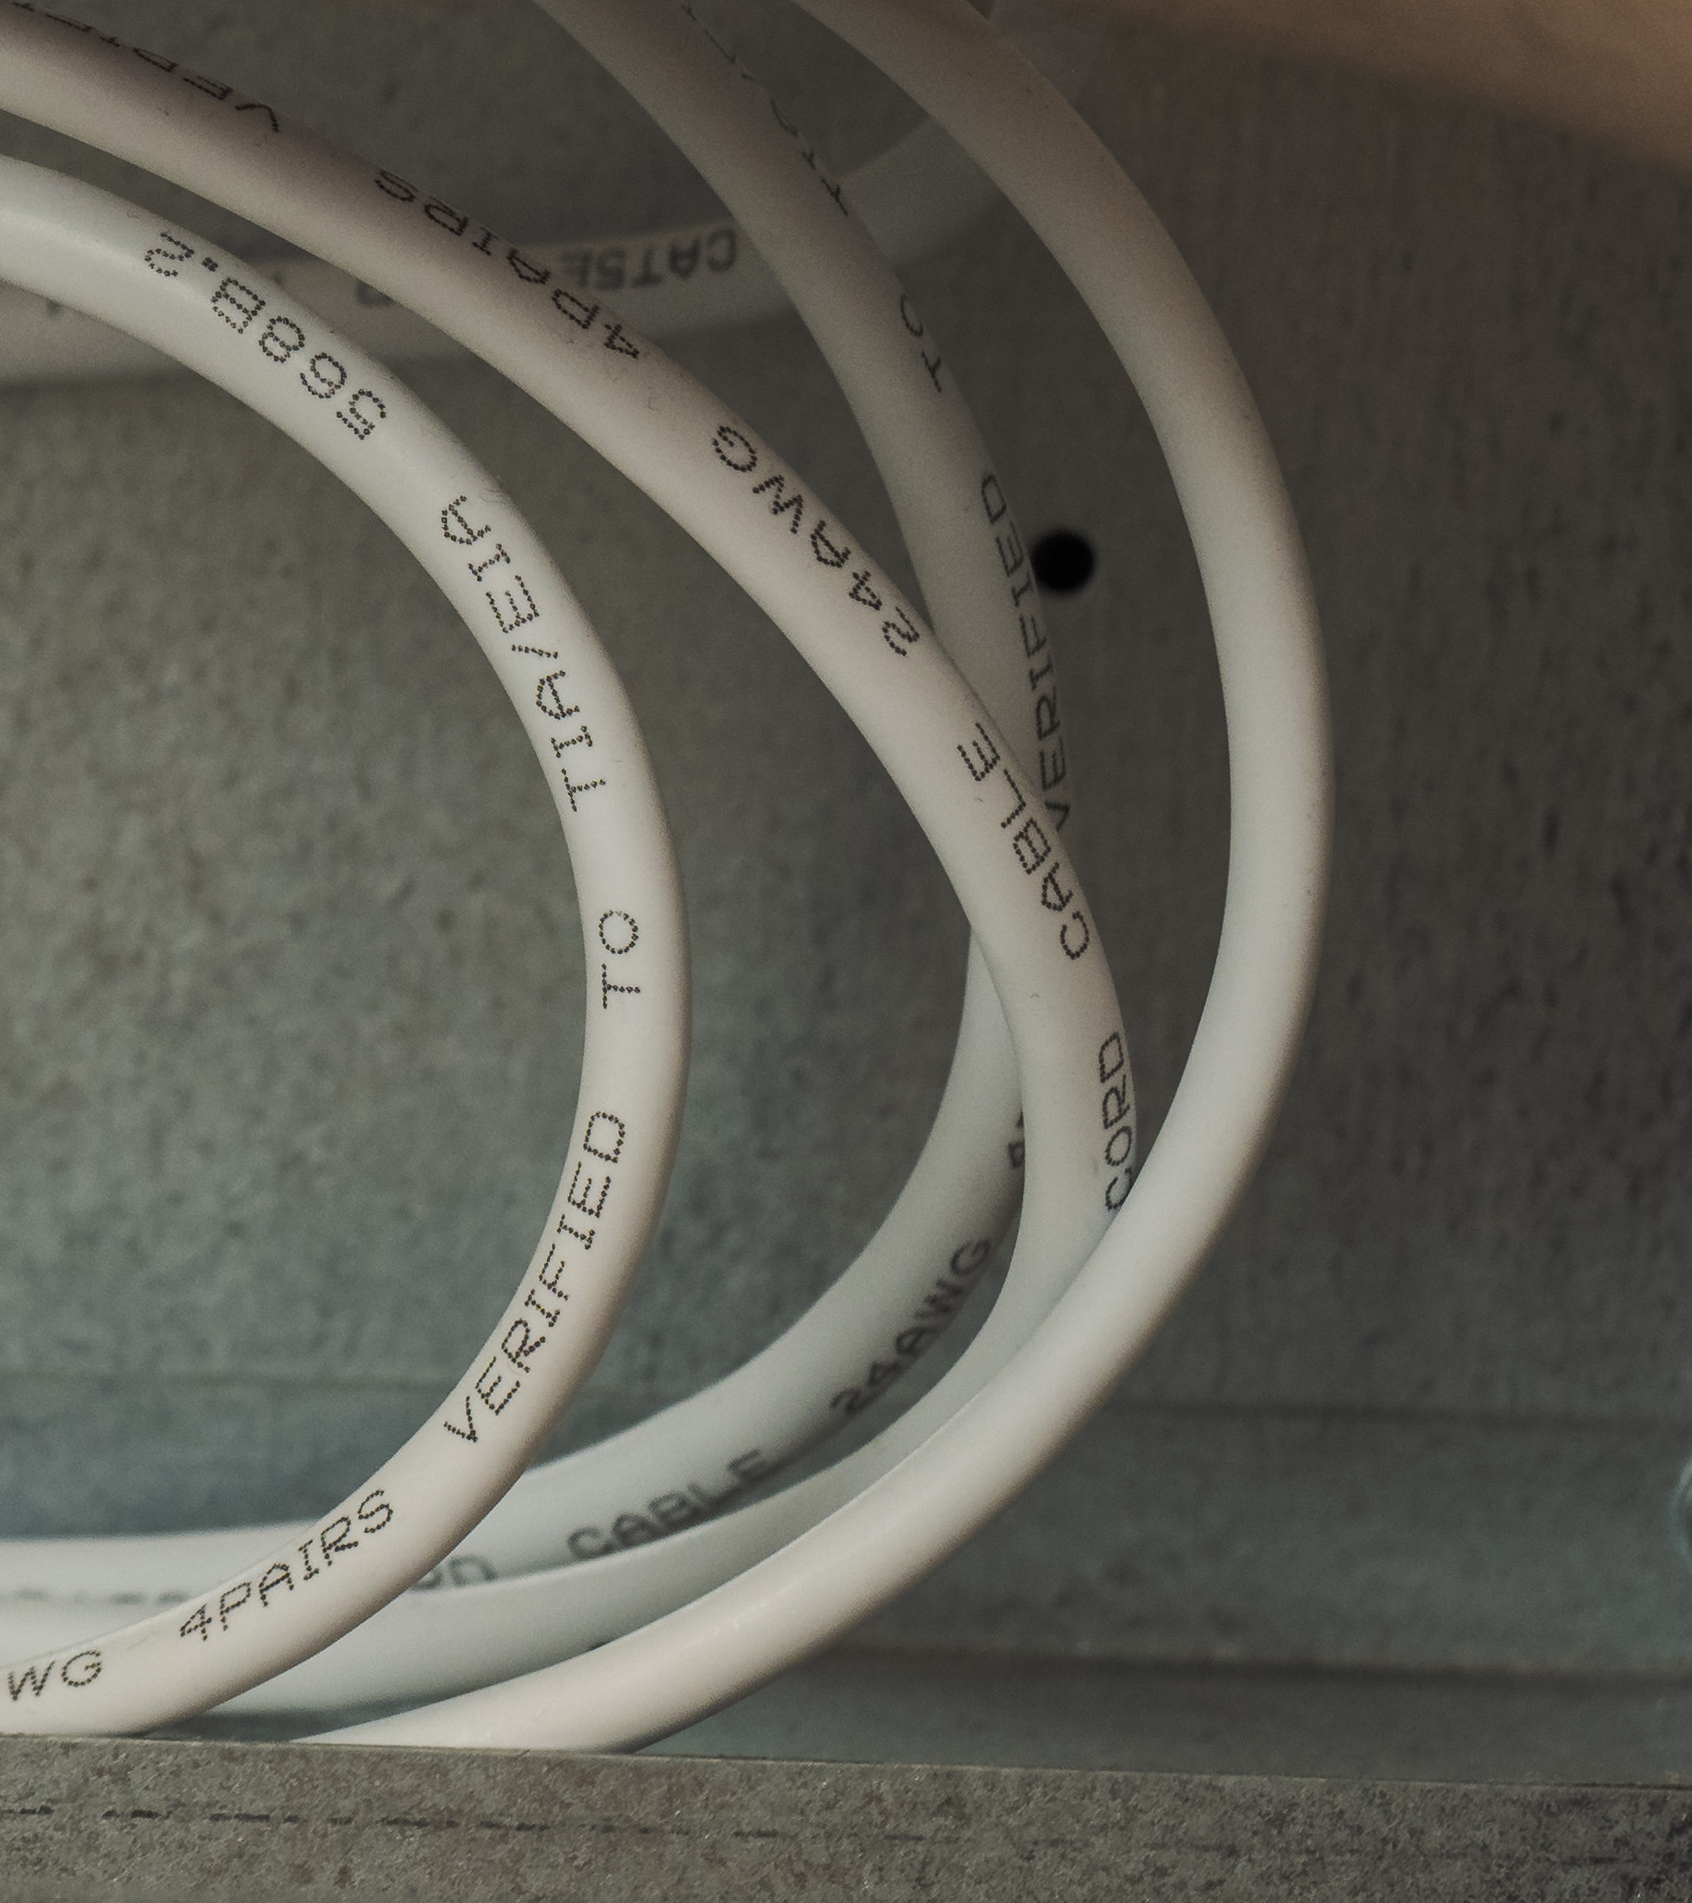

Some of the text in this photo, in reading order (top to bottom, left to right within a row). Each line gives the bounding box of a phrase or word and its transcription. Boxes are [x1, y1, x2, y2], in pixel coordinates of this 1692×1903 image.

[144, 231, 388, 440] 568B.2
[374, 168, 639, 359] 4PAIRS
[712, 425, 921, 658] 24AWG
[440, 494, 608, 813] TIA/EIA
[956, 722, 1091, 961] CABLE
[598, 909, 641, 1009] TO
[443, 1110, 626, 1442] VERIFIED
[178, 1488, 393, 1641] 4PAIRS
